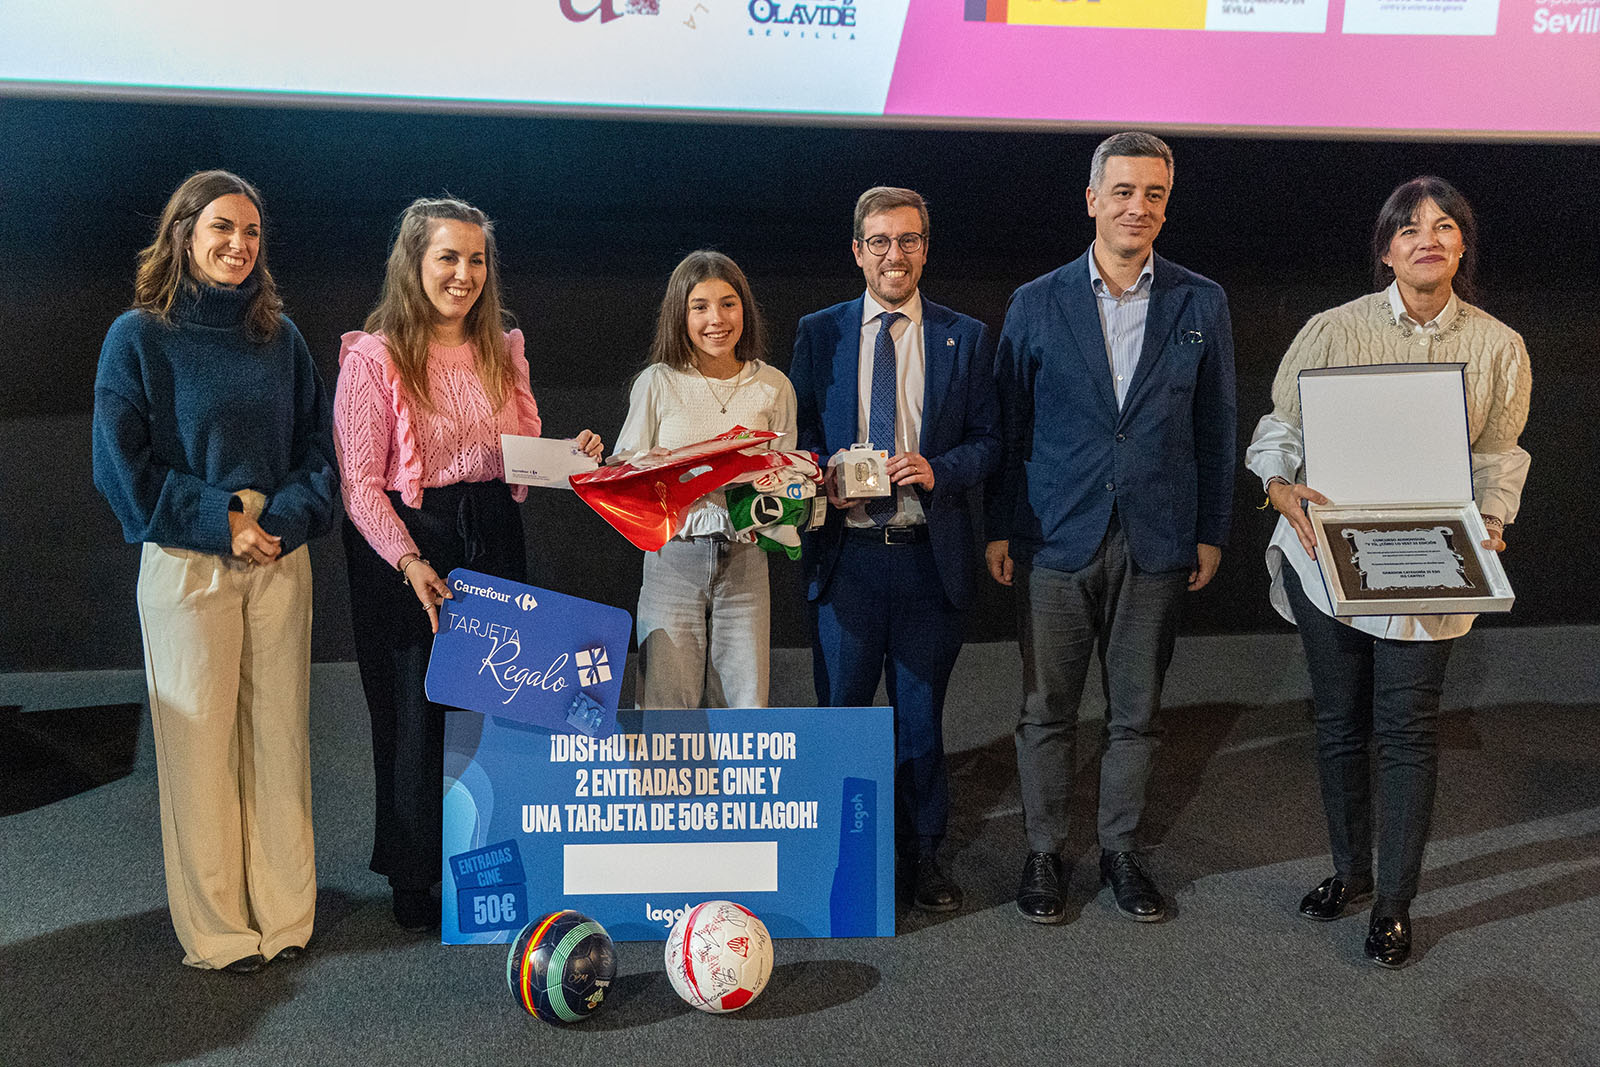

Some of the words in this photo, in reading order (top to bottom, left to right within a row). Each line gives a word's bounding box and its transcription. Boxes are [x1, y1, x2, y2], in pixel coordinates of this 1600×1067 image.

[748, 0, 856, 27] OLAVIDE
[454, 579, 511, 603] Carrefour
[448, 613, 520, 643] TARJETA
[478, 636, 569, 705] Regalo
[652, 733, 677, 761] DE
[680, 732, 705, 761] TU
[708, 732, 755, 761] VALE
[757, 732, 796, 760] POR
[575, 769, 589, 797] 2
[592, 768, 692, 797] ENTRADAS
[695, 768, 720, 796] DE
[722, 767, 766, 795] CINE
[769, 767, 781, 795] Y
[522, 804, 562, 833] UNA
[565, 803, 648, 832] TARJETA
[651, 803, 675, 832] DE
[678, 802, 719, 832] 50€
[722, 802, 746, 830] EN
[750, 801, 818, 830] LAGOH!
[457, 847, 513, 876] ENTRADAS
[476, 867, 503, 887] CINE
[473, 892, 517, 925] 50€
